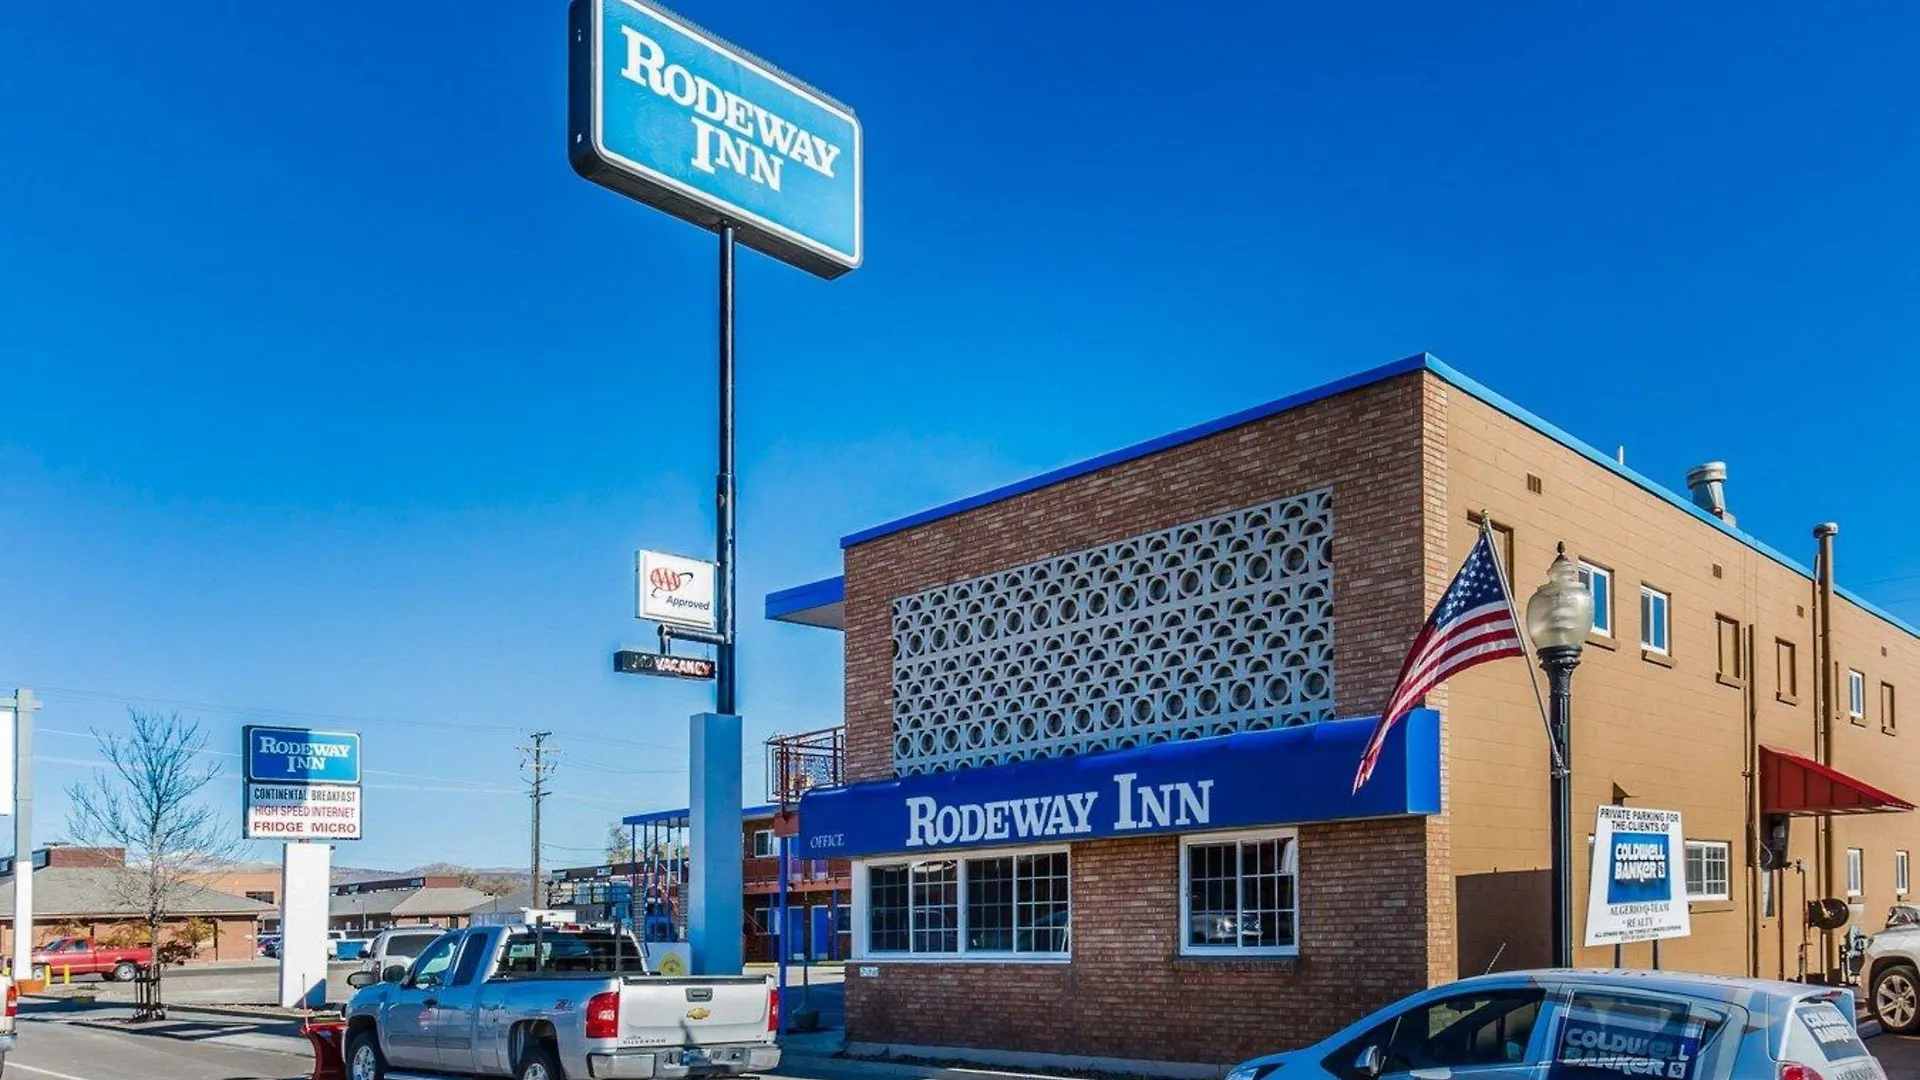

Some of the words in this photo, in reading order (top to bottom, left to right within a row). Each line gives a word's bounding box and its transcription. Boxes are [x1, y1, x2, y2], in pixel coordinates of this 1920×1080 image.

[621, 24, 840, 178] RODEWAY
[691, 116, 783, 192] INN
[666, 595, 710, 611] Approved
[654, 657, 712, 676] VACANCY
[260, 736, 351, 757] RODEWAY
[287, 755, 327, 773] INN
[254, 787, 307, 801] CONTINENTAL
[311, 789, 356, 803] BREAKFAST
[254, 805, 278, 817] HIGH
[280, 805, 310, 817] SPEED
[311, 806, 355, 818] INTERNET
[905, 791, 1098, 848] RODEWAY
[1113, 772, 1214, 830] INN
[1600, 808, 1631, 820] PRIVATE
[1632, 810, 1665, 822] PARKING
[1666, 812, 1679, 823] FOR
[254, 821, 304, 833] FRIDGE
[311, 822, 356, 834] MICRO
[1628, 821, 1659, 832] CLIENTS
[810, 833, 845, 848] OFFICE
[1615, 842, 1666, 861] COLDWELL
[1614, 861, 1657, 882] BANKER
[1565, 1027, 1690, 1061] COLDWELL
[1563, 1047, 1665, 1076] BANKER
